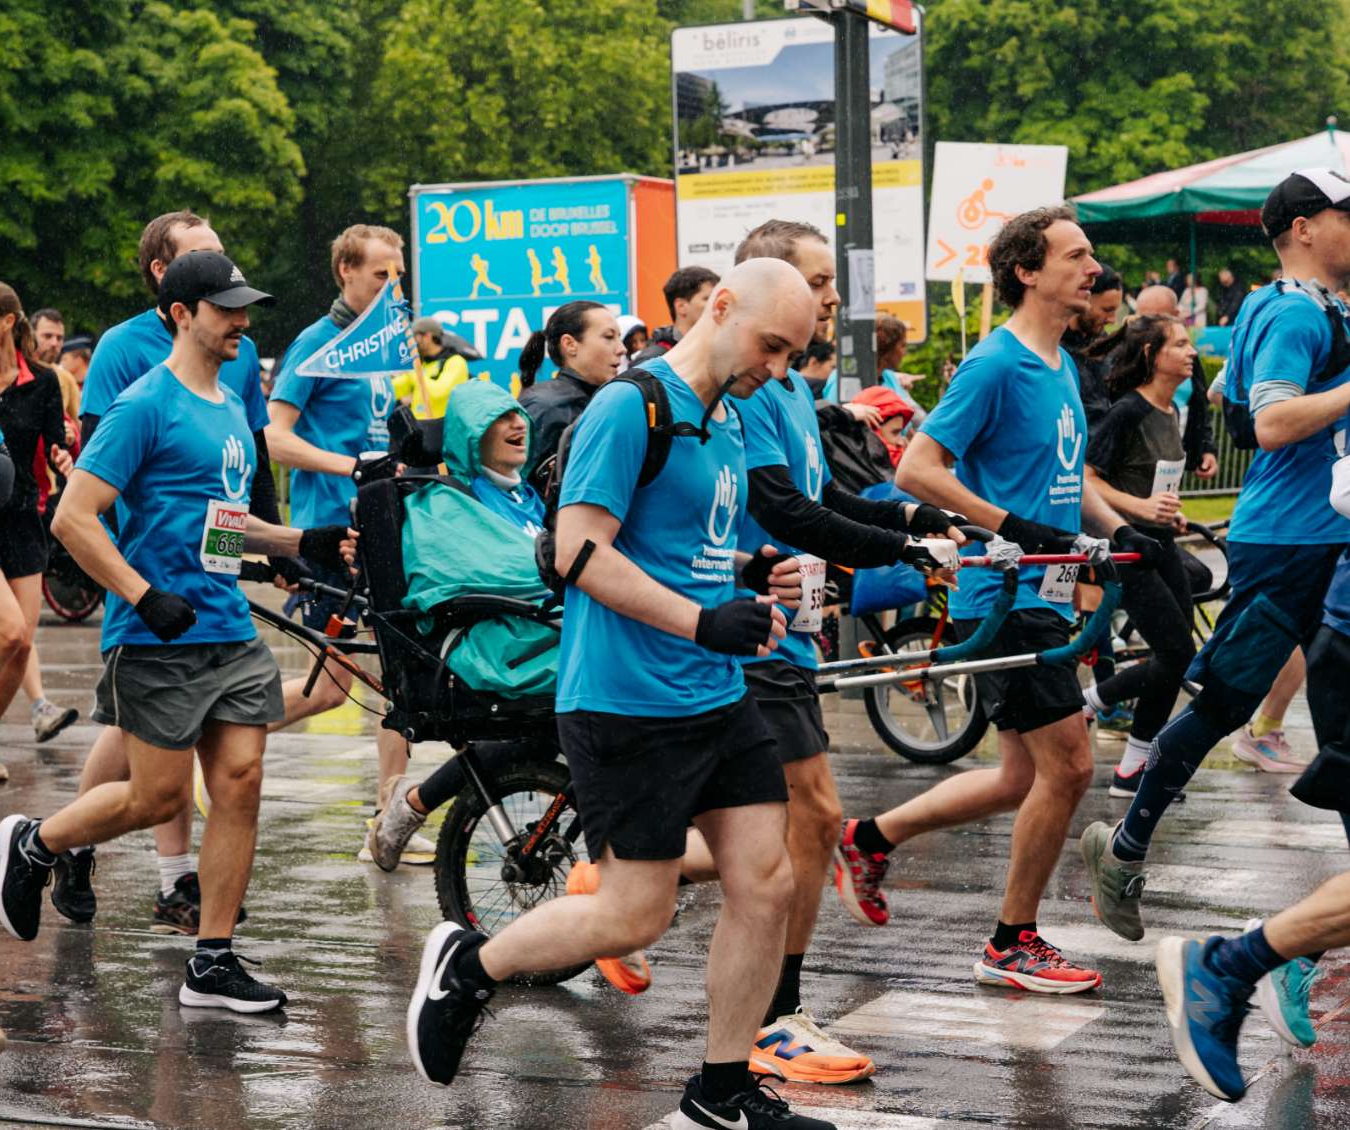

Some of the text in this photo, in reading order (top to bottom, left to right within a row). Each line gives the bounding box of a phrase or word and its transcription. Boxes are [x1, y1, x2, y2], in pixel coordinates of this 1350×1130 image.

[425, 199, 524, 244] 20 km
[529, 204, 611, 222] DE BRUXELLES
[530, 220, 618, 238] DOOR BRUSSEL
[325, 315, 405, 369] CHRISTINE
